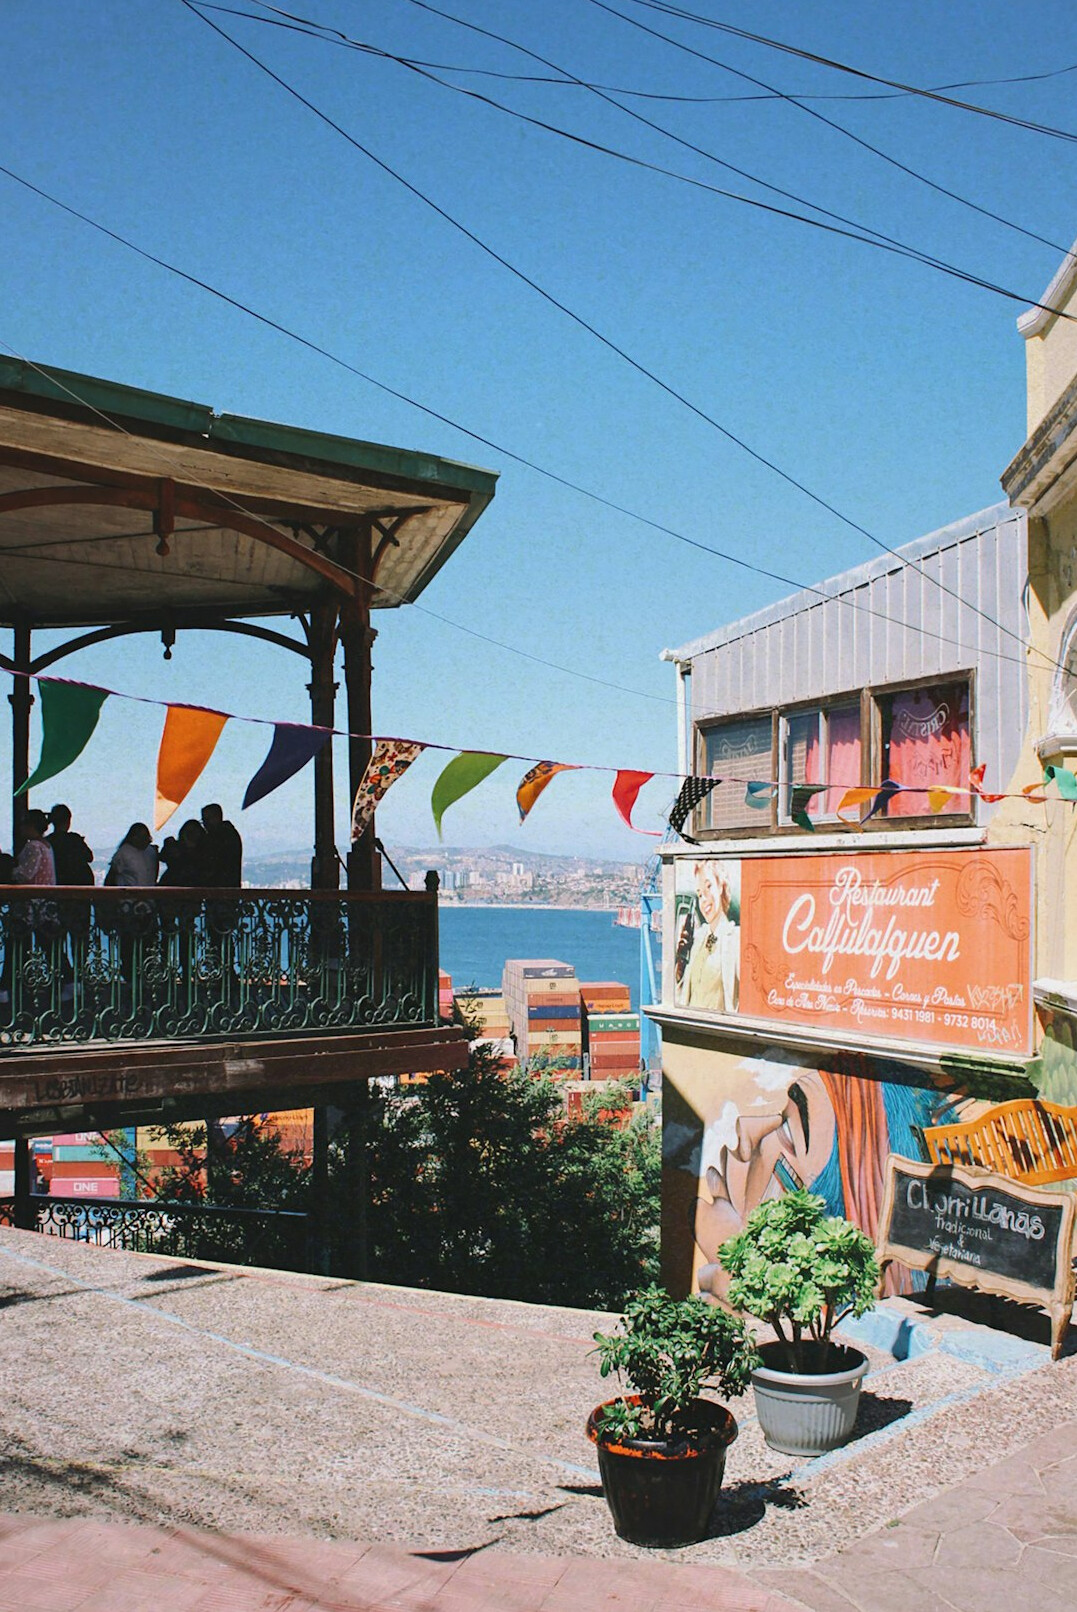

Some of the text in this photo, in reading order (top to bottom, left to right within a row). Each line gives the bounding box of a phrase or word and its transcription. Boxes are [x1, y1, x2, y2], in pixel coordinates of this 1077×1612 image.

[829, 866, 941, 927] Restaurant
[922, 995, 930, 1009] y
[931, 986, 966, 1007] Pastas
[891, 1007, 913, 1020] 9431
[915, 1009, 935, 1023] 1981
[943, 1013, 968, 1028] 9732
[970, 1016, 996, 1031] 8014
[73, 1182, 98, 1192] ONE
